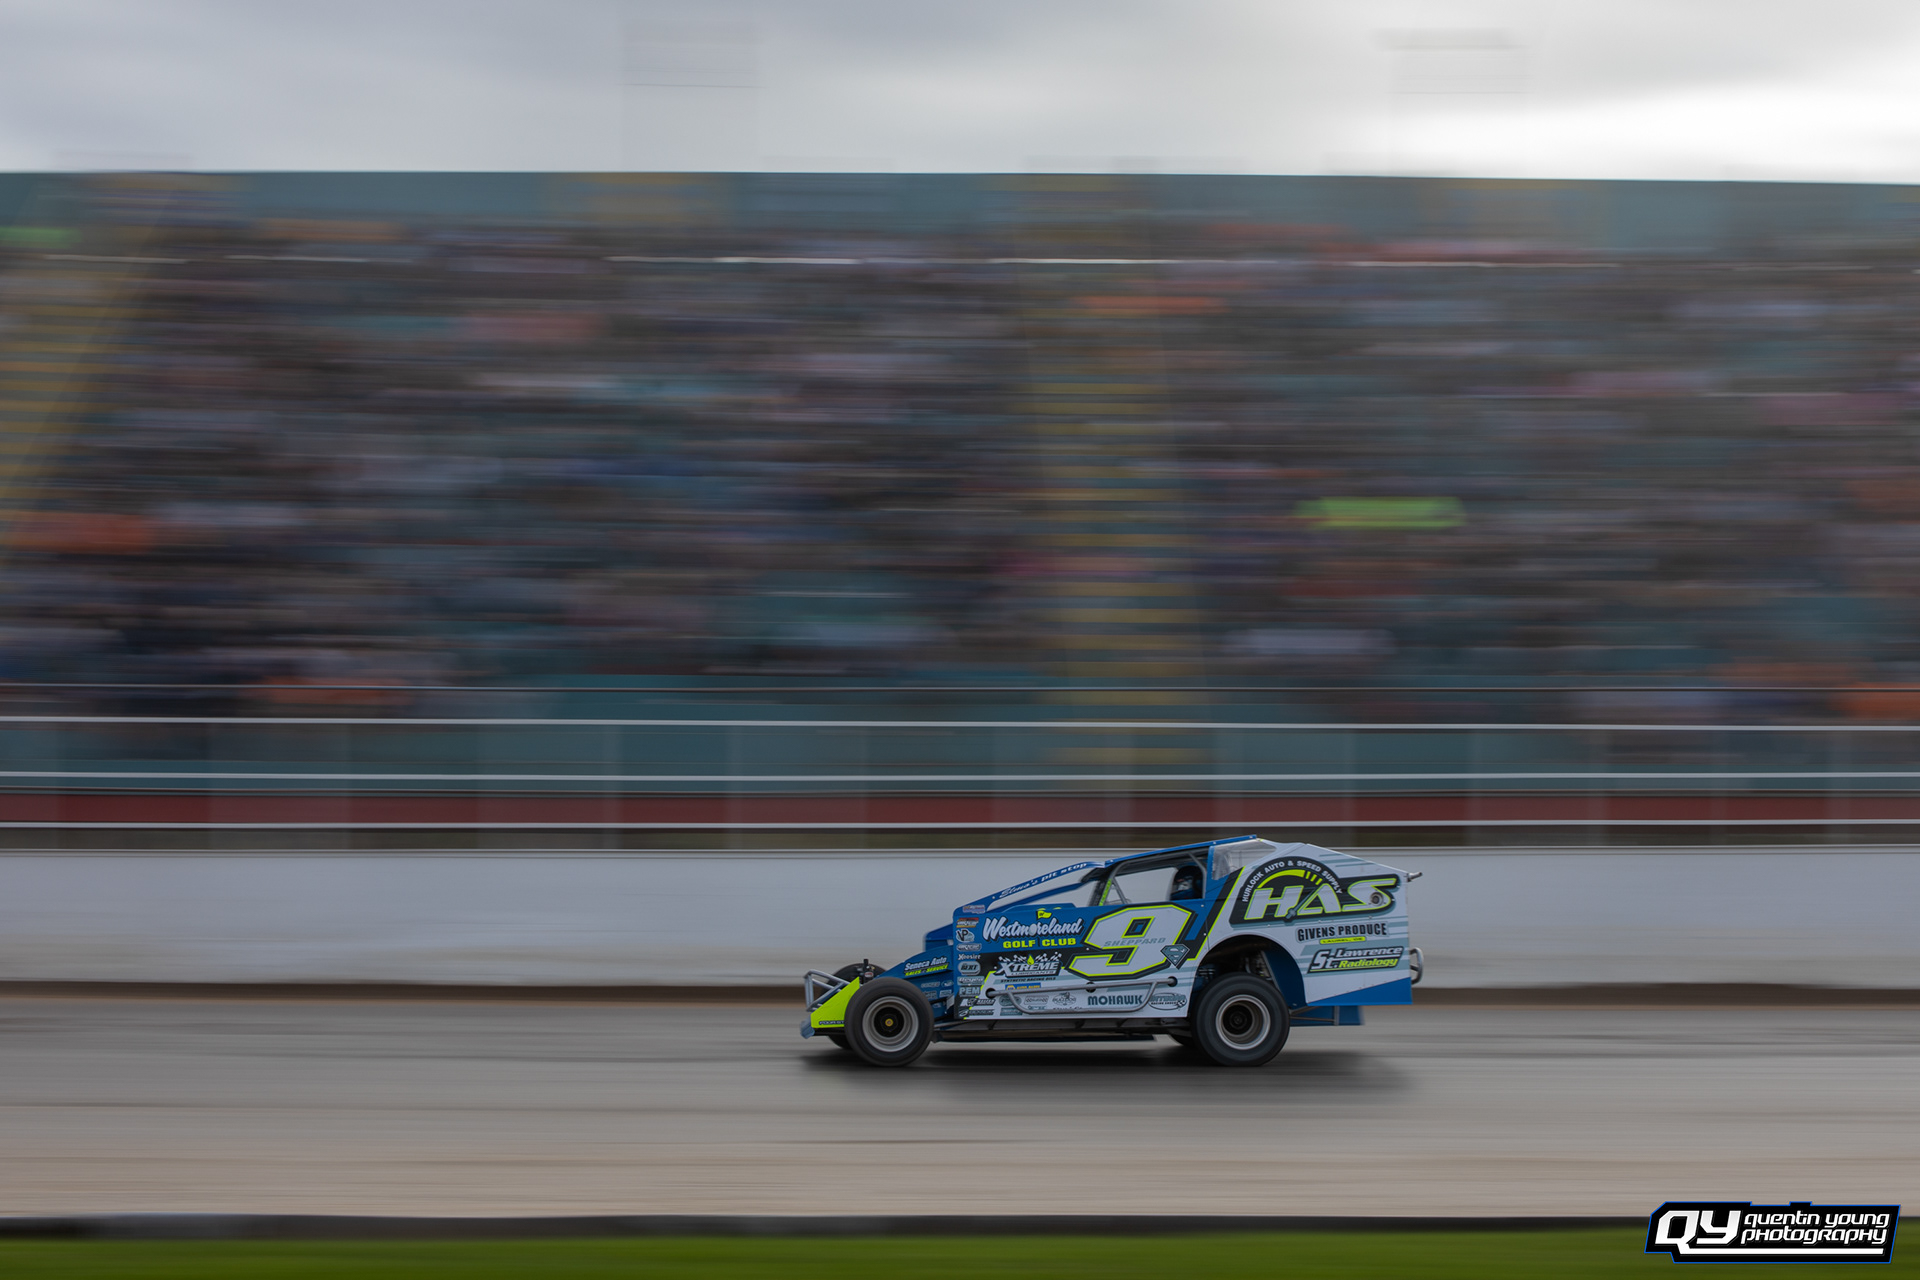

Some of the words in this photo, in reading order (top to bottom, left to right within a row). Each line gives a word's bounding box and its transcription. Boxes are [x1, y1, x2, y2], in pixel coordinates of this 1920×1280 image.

[1242, 871, 1264, 902] HURLOCK
[1264, 861, 1285, 874] AUTO
[1297, 860, 1322, 873] SPEED
[1321, 868, 1343, 895] SUPPLY
[1244, 878, 1397, 920] HAS
[983, 916, 1083, 940] Westmoreland
[1297, 926, 1335, 941] GIVENS
[1338, 923, 1387, 936] PRODUCE
[1003, 939, 1036, 949] GOLF
[1041, 938, 1076, 947] CLUB
[1069, 904, 1192, 977] 9
[1104, 937, 1166, 947] SHEPPARD
[1336, 947, 1403, 958] Lawrence
[904, 960, 930, 971] Seneca
[930, 957, 947, 966] Auto
[994, 962, 1061, 976] XTREME
[1338, 958, 1399, 969] Radiology
[960, 987, 980, 995] PEM
[1087, 994, 1143, 1006] MOHAWK
